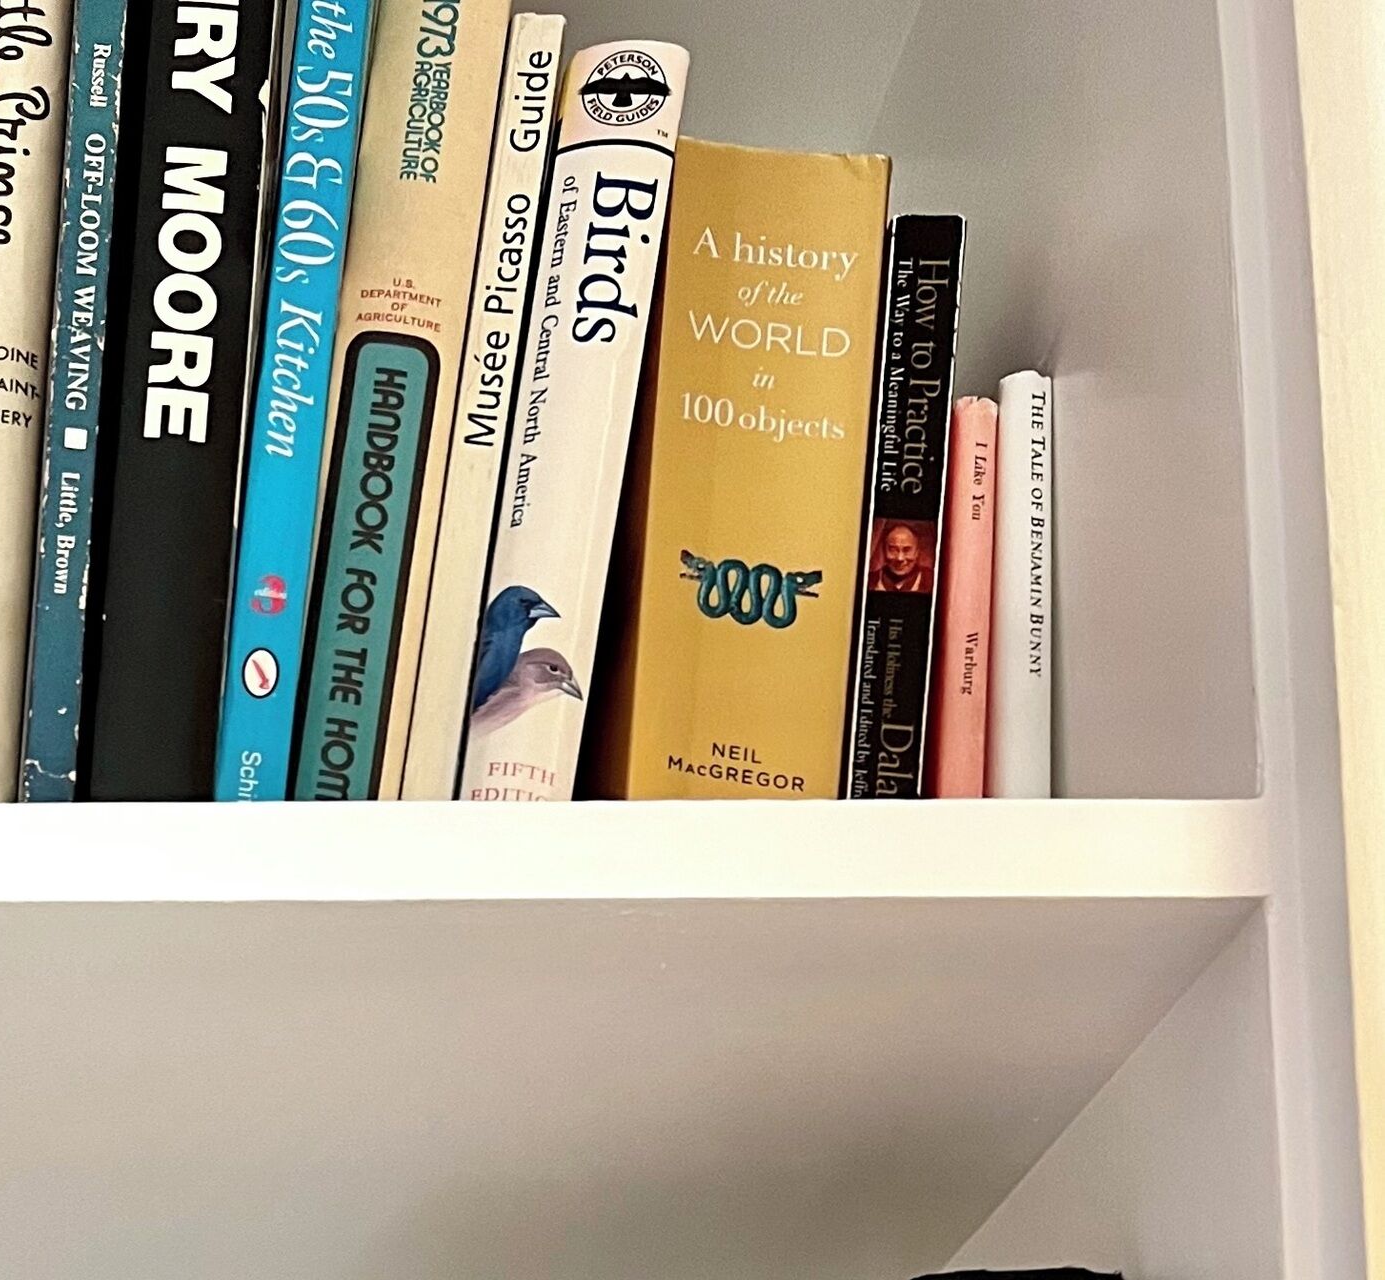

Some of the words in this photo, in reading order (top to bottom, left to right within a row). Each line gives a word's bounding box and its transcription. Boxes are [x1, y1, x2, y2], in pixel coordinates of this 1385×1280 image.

[90, 43, 112, 108] Russell
[509, 50, 552, 152] Guide
[76, 133, 106, 276] OFF-LOOM
[550, 200, 576, 270] Eastern
[485, 194, 531, 316] Picasso
[572, 171, 658, 344] Birds
[693, 228, 721, 258] A
[733, 233, 859, 281] history
[143, 147, 228, 443] MOORE
[544, 274, 562, 310] and
[915, 258, 951, 332] How
[64, 285, 96, 411] WEAVING
[532, 314, 559, 380] Central
[688, 312, 851, 358] WORLD
[910, 339, 936, 369] to
[266, 301, 323, 458] Kitchen
[464, 331, 510, 446] Musée
[1031, 392, 1047, 428] THE
[522, 387, 548, 445] North
[681, 394, 734, 427] 100
[738, 405, 845, 443] objects
[900, 377, 942, 494] Practice
[349, 367, 409, 555] HANDBOOK
[510, 451, 538, 529] America
[56, 472, 80, 528] Little,
[1030, 487, 1045, 511] OF
[54, 536, 74, 594] Brown
[337, 567, 377, 634] FOR
[329, 648, 368, 705] THE
[960, 632, 979, 696] Warburg
[712, 741, 761, 764] NEIL
